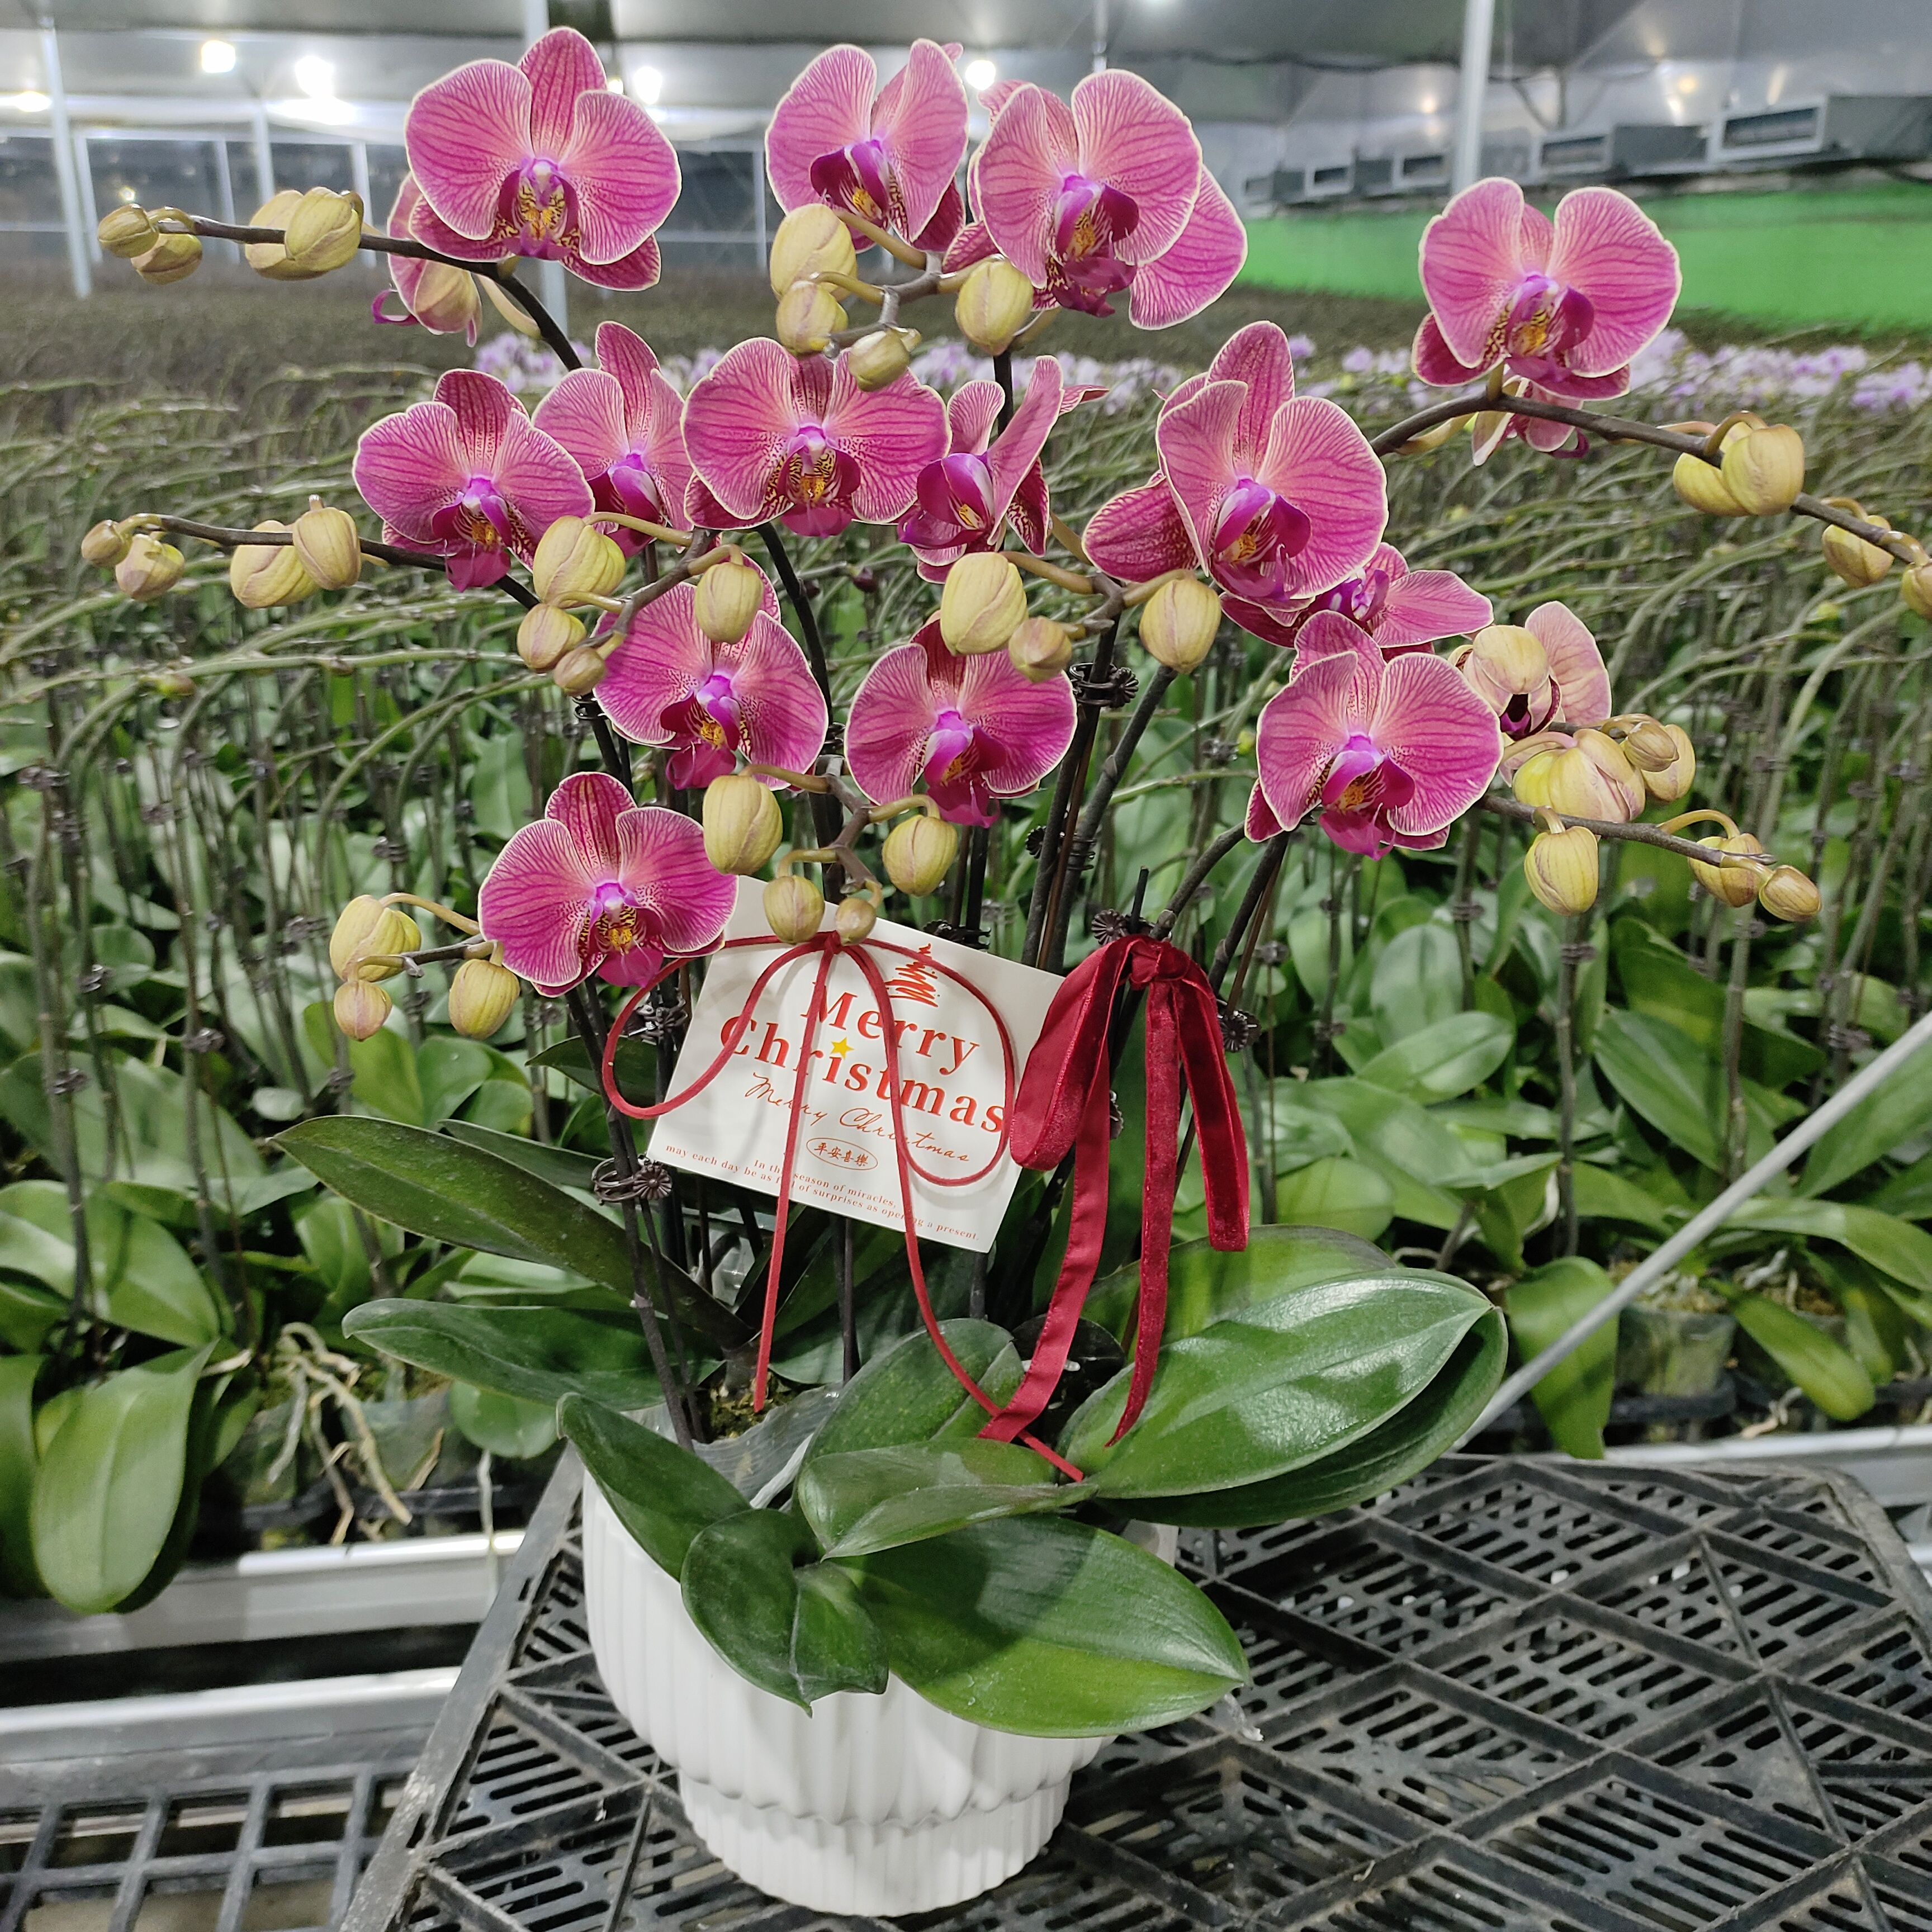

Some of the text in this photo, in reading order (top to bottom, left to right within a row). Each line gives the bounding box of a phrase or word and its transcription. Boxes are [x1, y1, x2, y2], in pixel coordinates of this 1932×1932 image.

[800, 981, 980, 1075] Merry
[745, 1072, 828, 1126] Merry
[814, 1142, 868, 1167] 平安喜樂
[839, 1107, 970, 1162] Chritmas
[665, 1145, 688, 1158] may
[692, 1153, 717, 1166] each
[721, 1161, 740, 1173] day
[744, 1167, 757, 1177] be
[760, 1174, 772, 1182] as
[775, 1176, 795, 1188] fl
[813, 1188, 864, 1209] surprises
[866, 1204, 878, 1213] as
[882, 1209, 924, 1227] openg
[753, 1159, 765, 1169] In
[793, 1173, 830, 1188] season
[833, 1183, 846, 1192] of
[847, 1188, 896, 1209] miracles,
